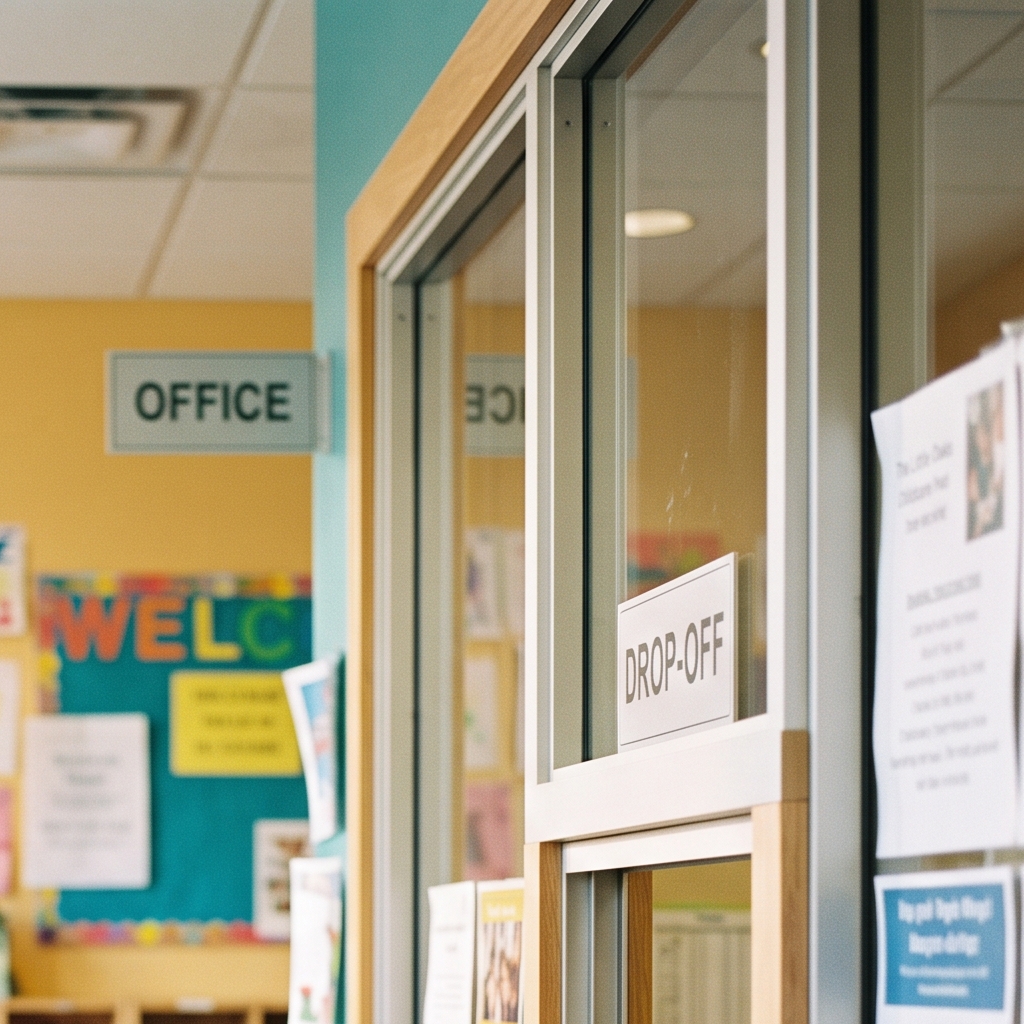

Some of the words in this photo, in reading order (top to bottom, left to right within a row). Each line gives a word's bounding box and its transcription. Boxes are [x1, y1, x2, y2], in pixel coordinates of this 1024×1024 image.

[134, 380, 292, 423] OFFICE
[56, 595, 312, 662] WELC
[626, 610, 724, 704] DROP-OFF
